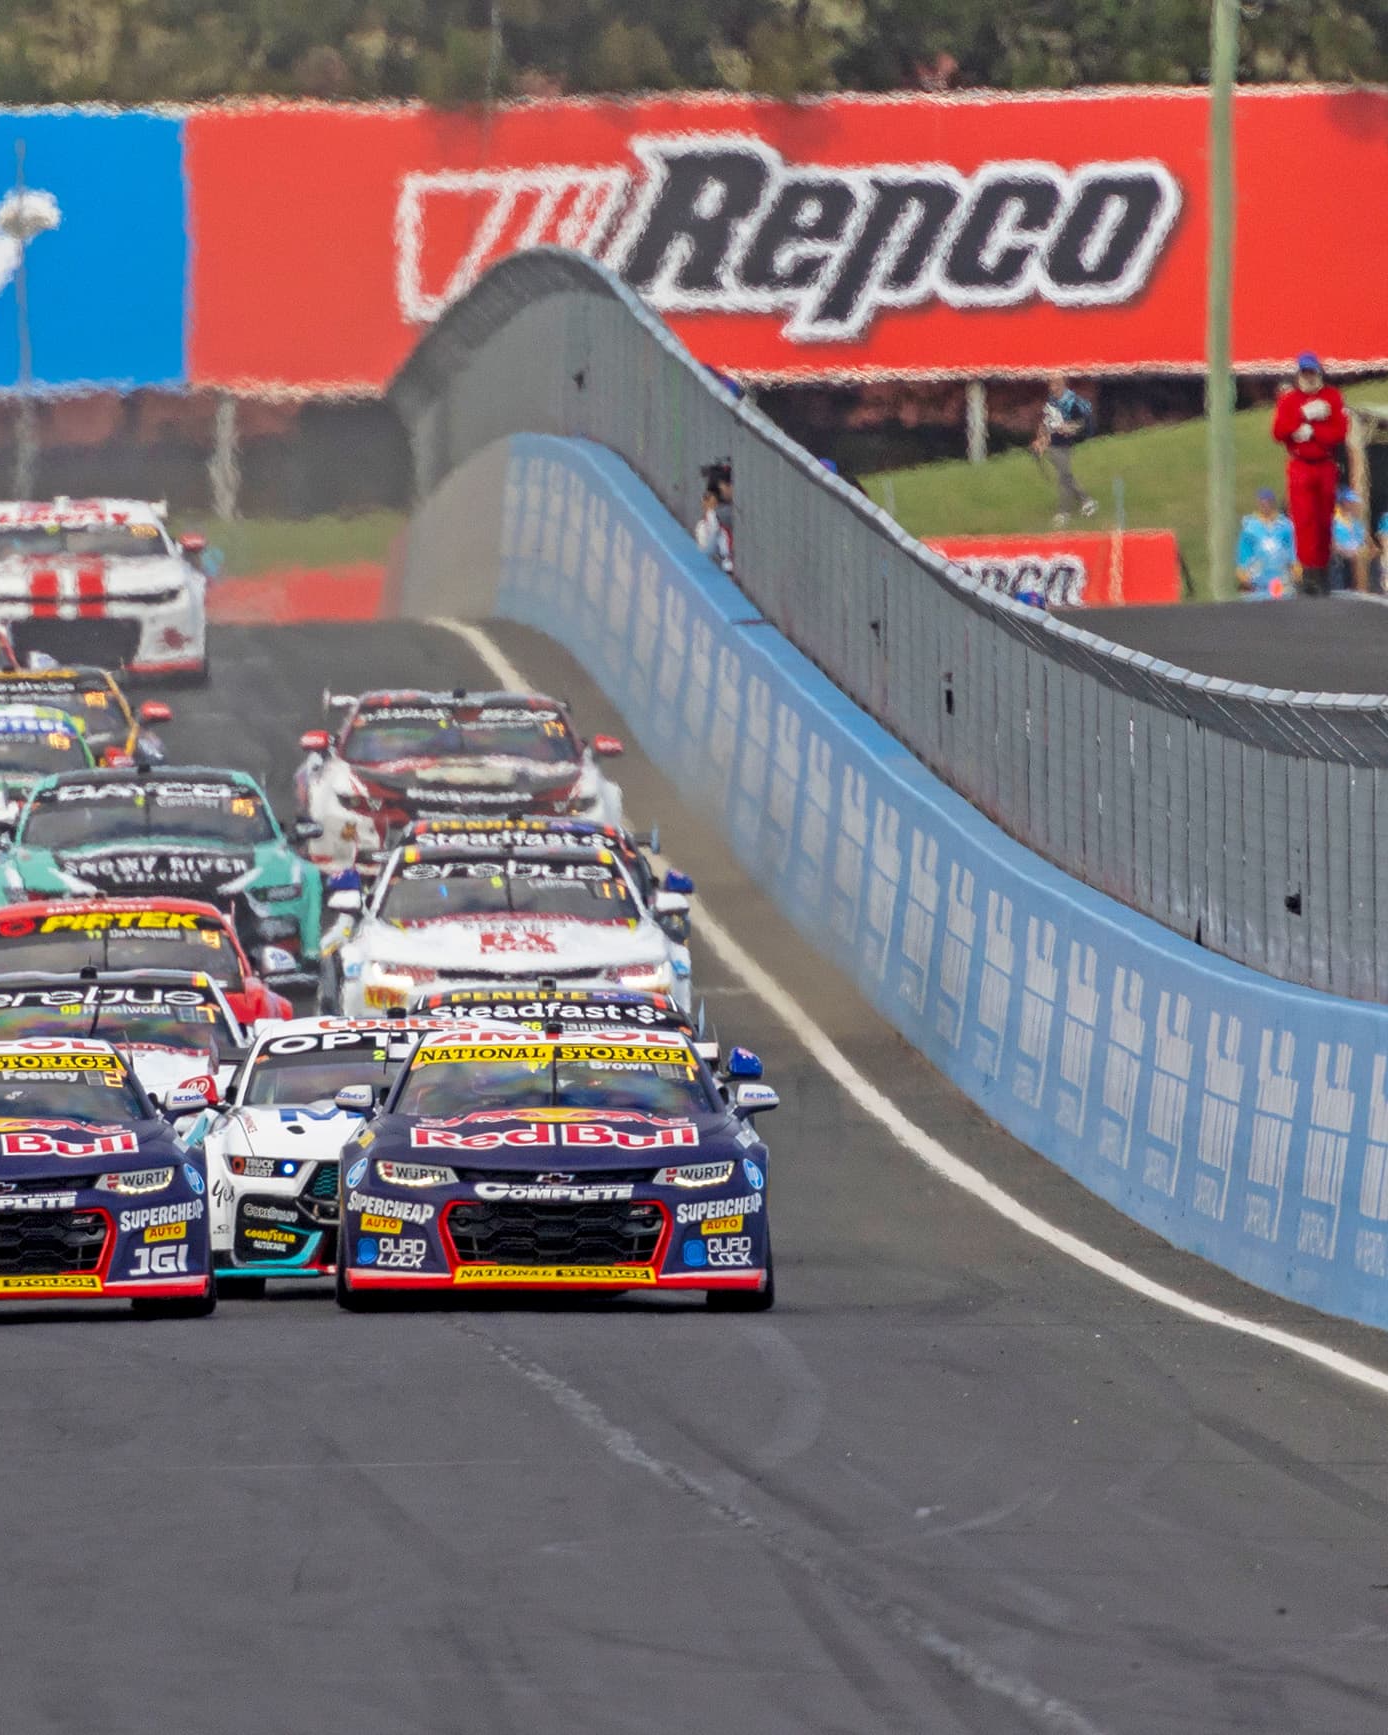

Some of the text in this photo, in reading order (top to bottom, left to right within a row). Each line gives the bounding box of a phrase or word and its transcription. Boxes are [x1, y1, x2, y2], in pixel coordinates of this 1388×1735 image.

[617, 131, 1182, 343] Repco
[40, 911, 200, 932] PIRTEK
[452, 991, 588, 1002] PENRITE
[84, 1003, 171, 1016] Hazelwood
[430, 1002, 622, 1020] Steadfast
[318, 1017, 480, 1031] Coates
[421, 1047, 685, 1061] NATIONAL STORAGE
[590, 1062, 653, 1072] Brown
[3, 1070, 79, 1083] Feeney
[411, 1123, 700, 1150] Red Bull
[1, 1132, 140, 1158] Bull
[246, 1158, 275, 1167] TRUCK
[122, 1169, 170, 1186] WÜRTH
[244, 1167, 274, 1177] ASSIST
[396, 1167, 448, 1182] WÜRTH
[680, 1165, 730, 1180] WÜRTH
[474, 1183, 634, 1201] COMPLETE
[348, 1190, 435, 1224] SUPERCHEAP
[677, 1192, 762, 1224] SUPERCHEAP
[119, 1199, 204, 1232] SUPERCHEAP
[365, 1218, 398, 1229] AUTO
[148, 1226, 182, 1238] AUTO
[706, 1219, 739, 1230] AUTO
[244, 1228, 297, 1244] GOODYEAR
[707, 1236, 752, 1252] QUAD
[378, 1237, 427, 1254] QUAD
[128, 1244, 189, 1276] JGI
[377, 1253, 426, 1269] LOCK
[707, 1251, 753, 1267] LOCK
[460, 1268, 651, 1280] NATIONAL STORAGE
[4, 1277, 98, 1289] STORAGE
